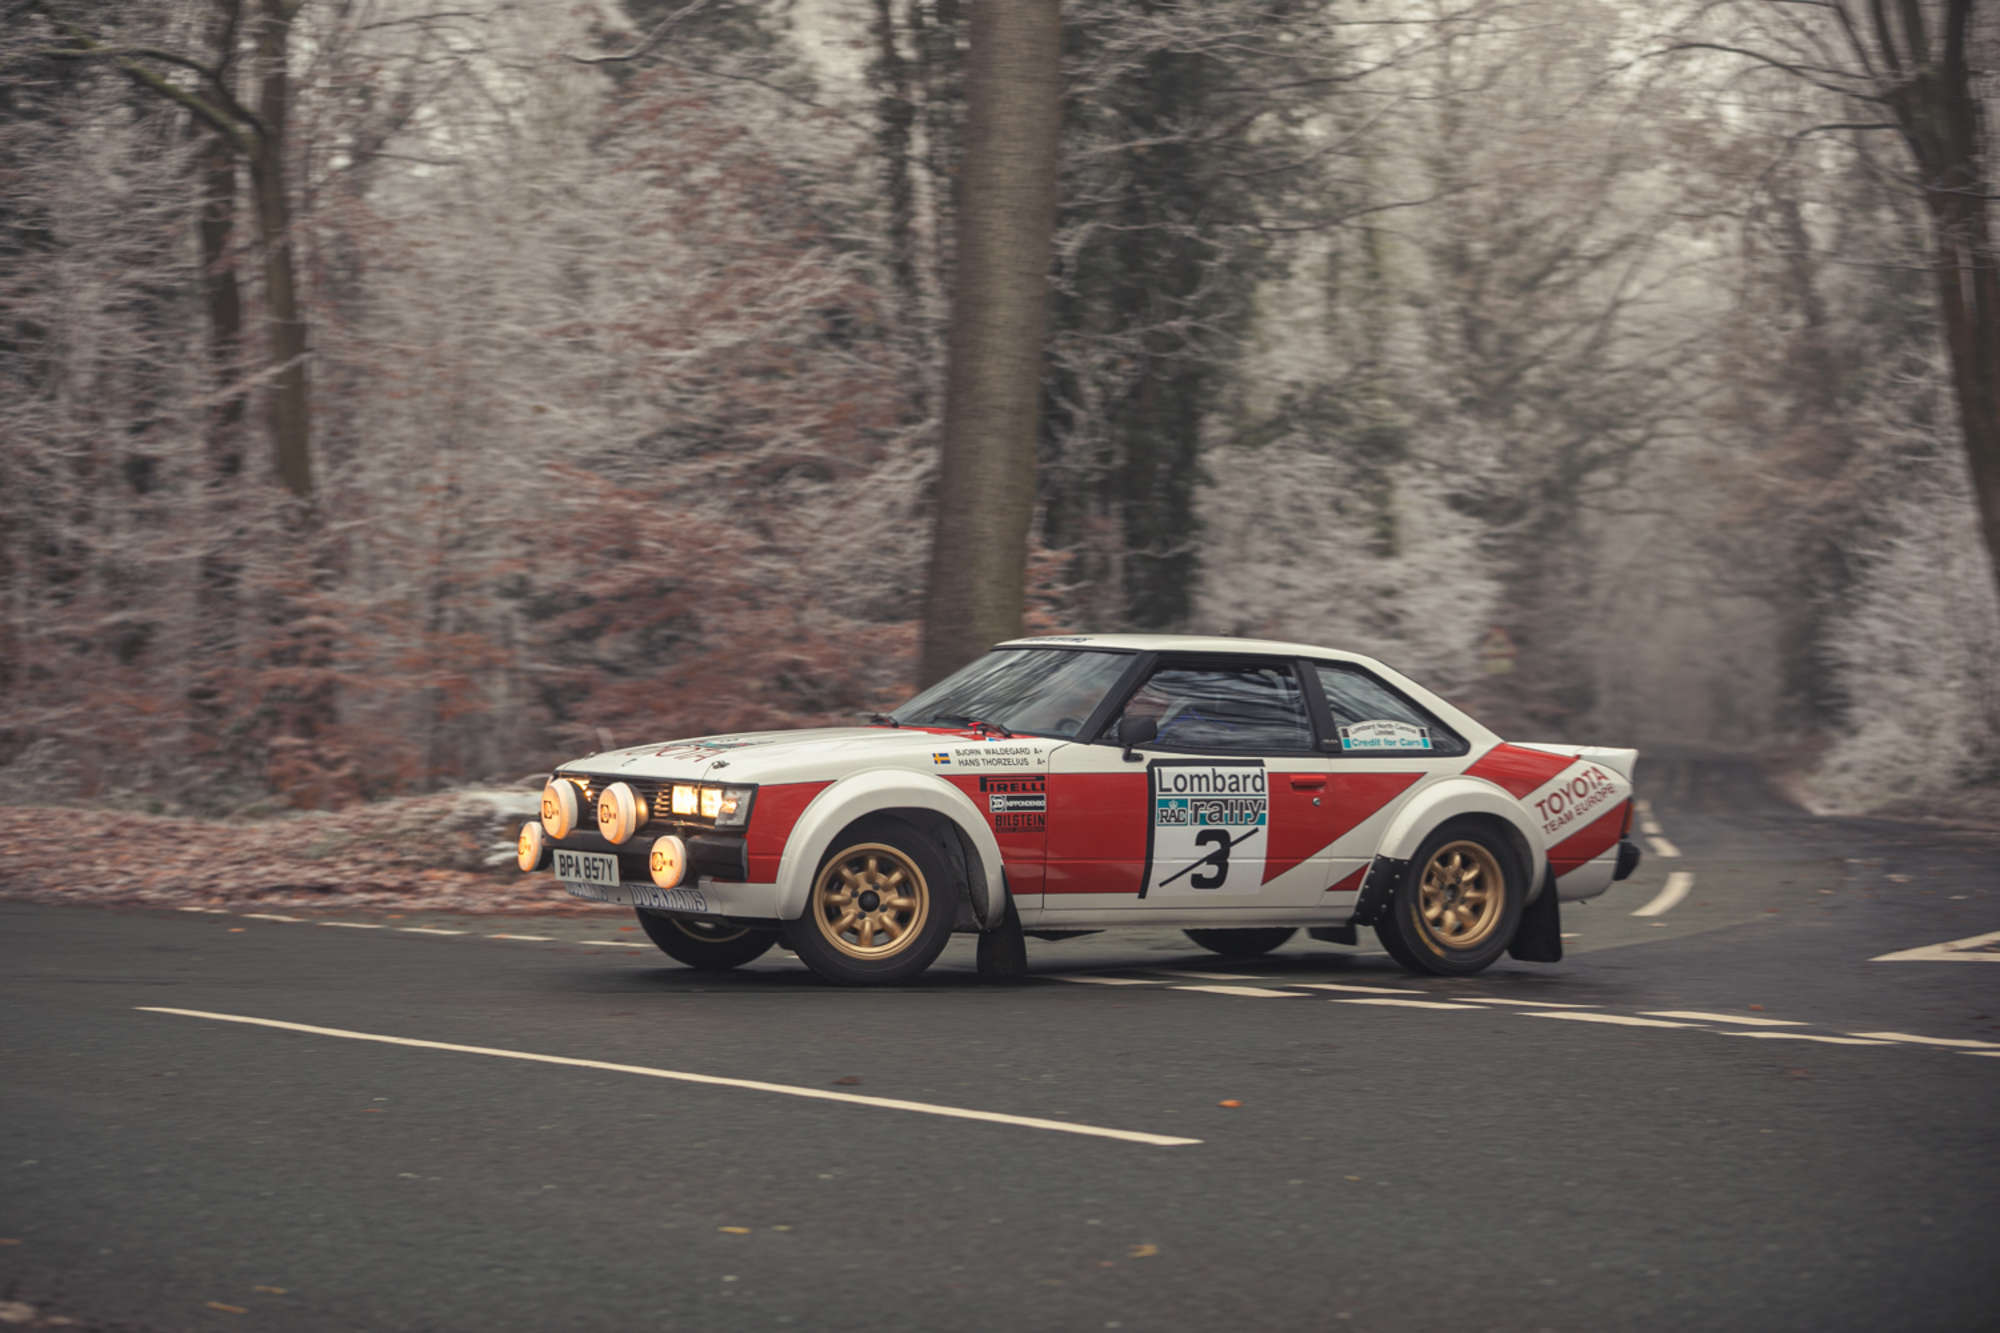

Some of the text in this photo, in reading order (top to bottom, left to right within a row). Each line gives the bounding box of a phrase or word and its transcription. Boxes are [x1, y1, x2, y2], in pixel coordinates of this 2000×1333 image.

[984, 747, 1031, 755] WALDEGARD
[1351, 737, 1421, 747] Credit for Cars
[958, 758, 981, 767] HANS
[981, 758, 1030, 766] THORZELIUS
[979, 775, 1045, 793] PIRELLI
[1157, 767, 1266, 793] Lombard
[1535, 766, 1609, 822] TOYOTA
[995, 814, 1046, 827] BILSTEIN
[1158, 799, 1265, 826] RAC rally
[1542, 783, 1617, 834] TEAM EUROPE
[558, 854, 615, 882] BPA 857Y
[632, 886, 708, 912] DUCKHAMS
